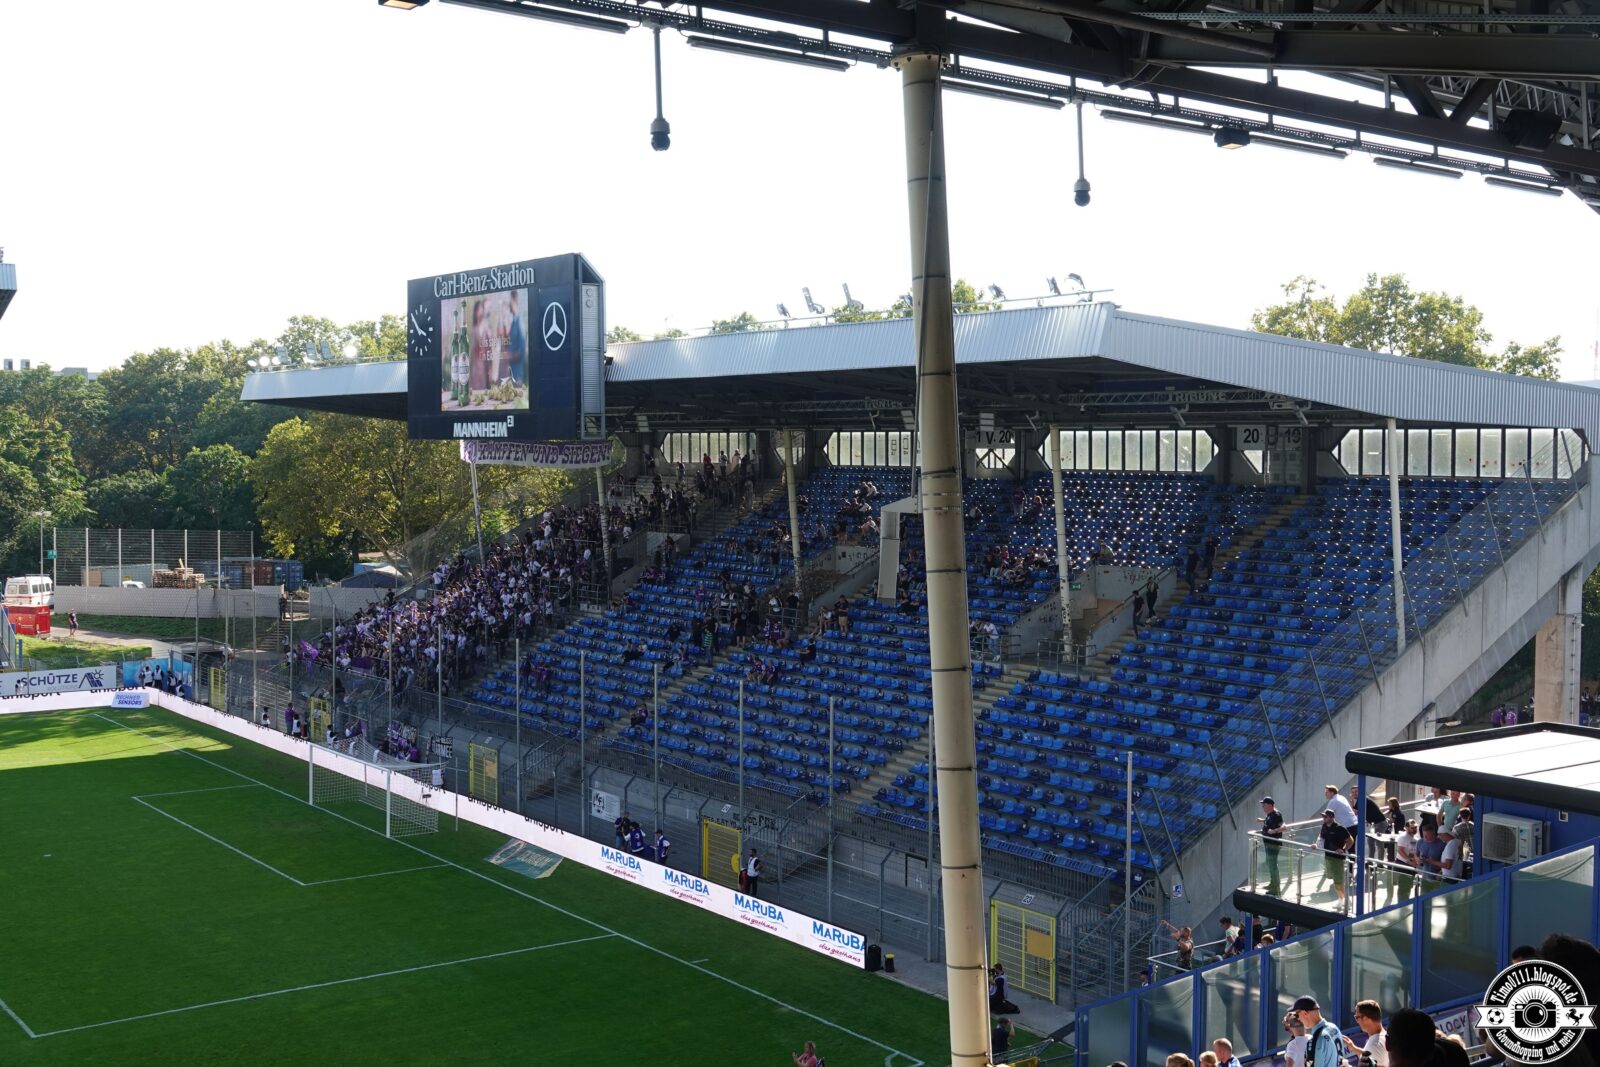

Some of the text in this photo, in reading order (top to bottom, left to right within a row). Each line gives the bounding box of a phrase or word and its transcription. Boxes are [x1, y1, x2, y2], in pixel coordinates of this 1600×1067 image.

[434, 264, 535, 298] Carl-Benz-Stadion
[453, 422, 508, 438] MANNHEIM
[1243, 428, 1259, 443] 20
[21, 673, 78, 687] SCHÜTZE
[1439, 1015, 1467, 1033] LOCK
